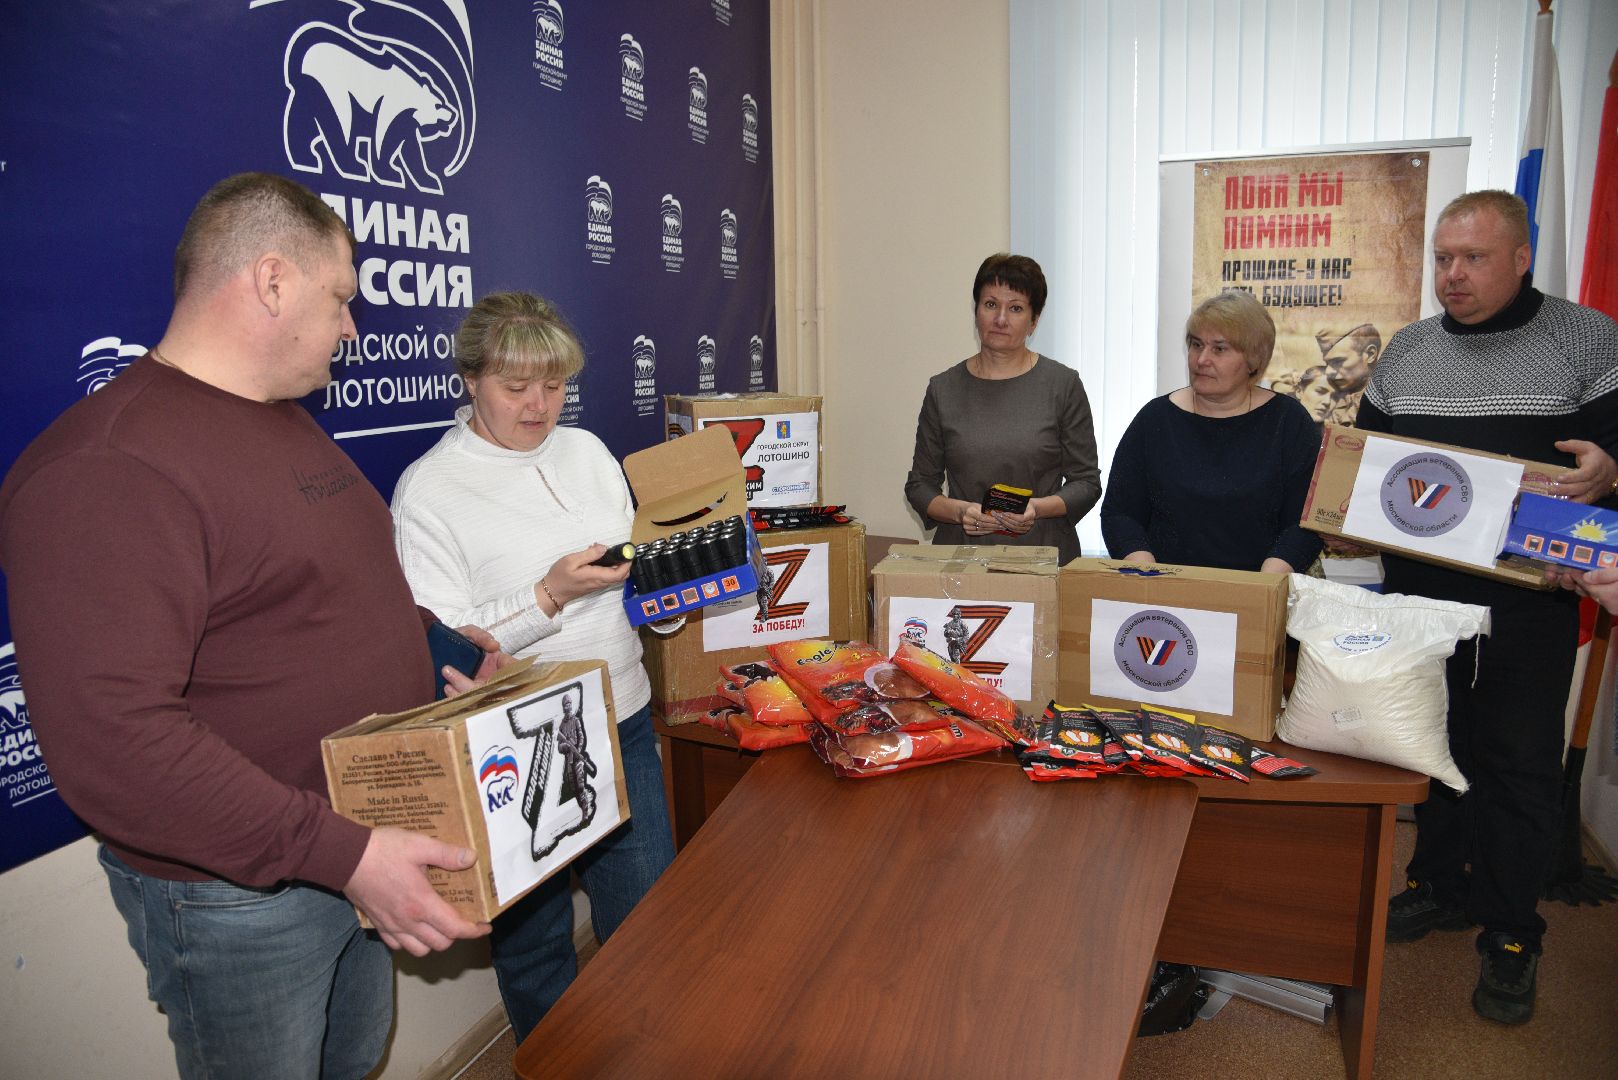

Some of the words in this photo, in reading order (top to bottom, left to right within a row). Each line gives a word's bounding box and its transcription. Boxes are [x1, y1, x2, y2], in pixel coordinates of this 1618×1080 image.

[535, 39, 563, 59] ЕДИНАЯ
[536, 50, 564, 69] РОССИЯ
[622, 86, 644, 101] РОССИЯ
[1225, 175, 1289, 210] ПОКА
[1298, 171, 1343, 207] МЫ
[320, 193, 470, 254] ДИНАЯ
[588, 222, 611, 234] ЕДИНАЯ
[1223, 213, 1332, 250] ПОМНИМ
[588, 232, 612, 243] РОССИЯ
[663, 244, 682, 254] РОССИЯ
[1321, 258, 1352, 279] НАС
[349, 257, 474, 308] ССИЯ
[1262, 285, 1342, 308] БУДУЩЕЕ!
[323, 373, 464, 410] ЛОТОШИНО
[634, 378, 655, 388] ЕДИНАЯ
[635, 387, 656, 396] РОССИЯ
[757, 442, 791, 450] ГОРОДСКОЙ
[757, 451, 810, 463] ЛОТОШИНО
[1387, 457, 1428, 487] Ассоциация
[1429, 458, 1465, 487] ветеранов
[1460, 485, 1469, 503] СВО
[1387, 500, 1424, 532] Московской
[1425, 513, 1458, 532] области
[752, 624, 764, 634] ЗА
[766, 619, 805, 632] ПОБЕДУ!
[1118, 615, 1151, 648] Ассоциация
[1122, 660, 1162, 687] Московской
[9, 775, 54, 799] ЛОТОШ
[367, 797, 391, 806] Made
[401, 794, 429, 803] Russia
